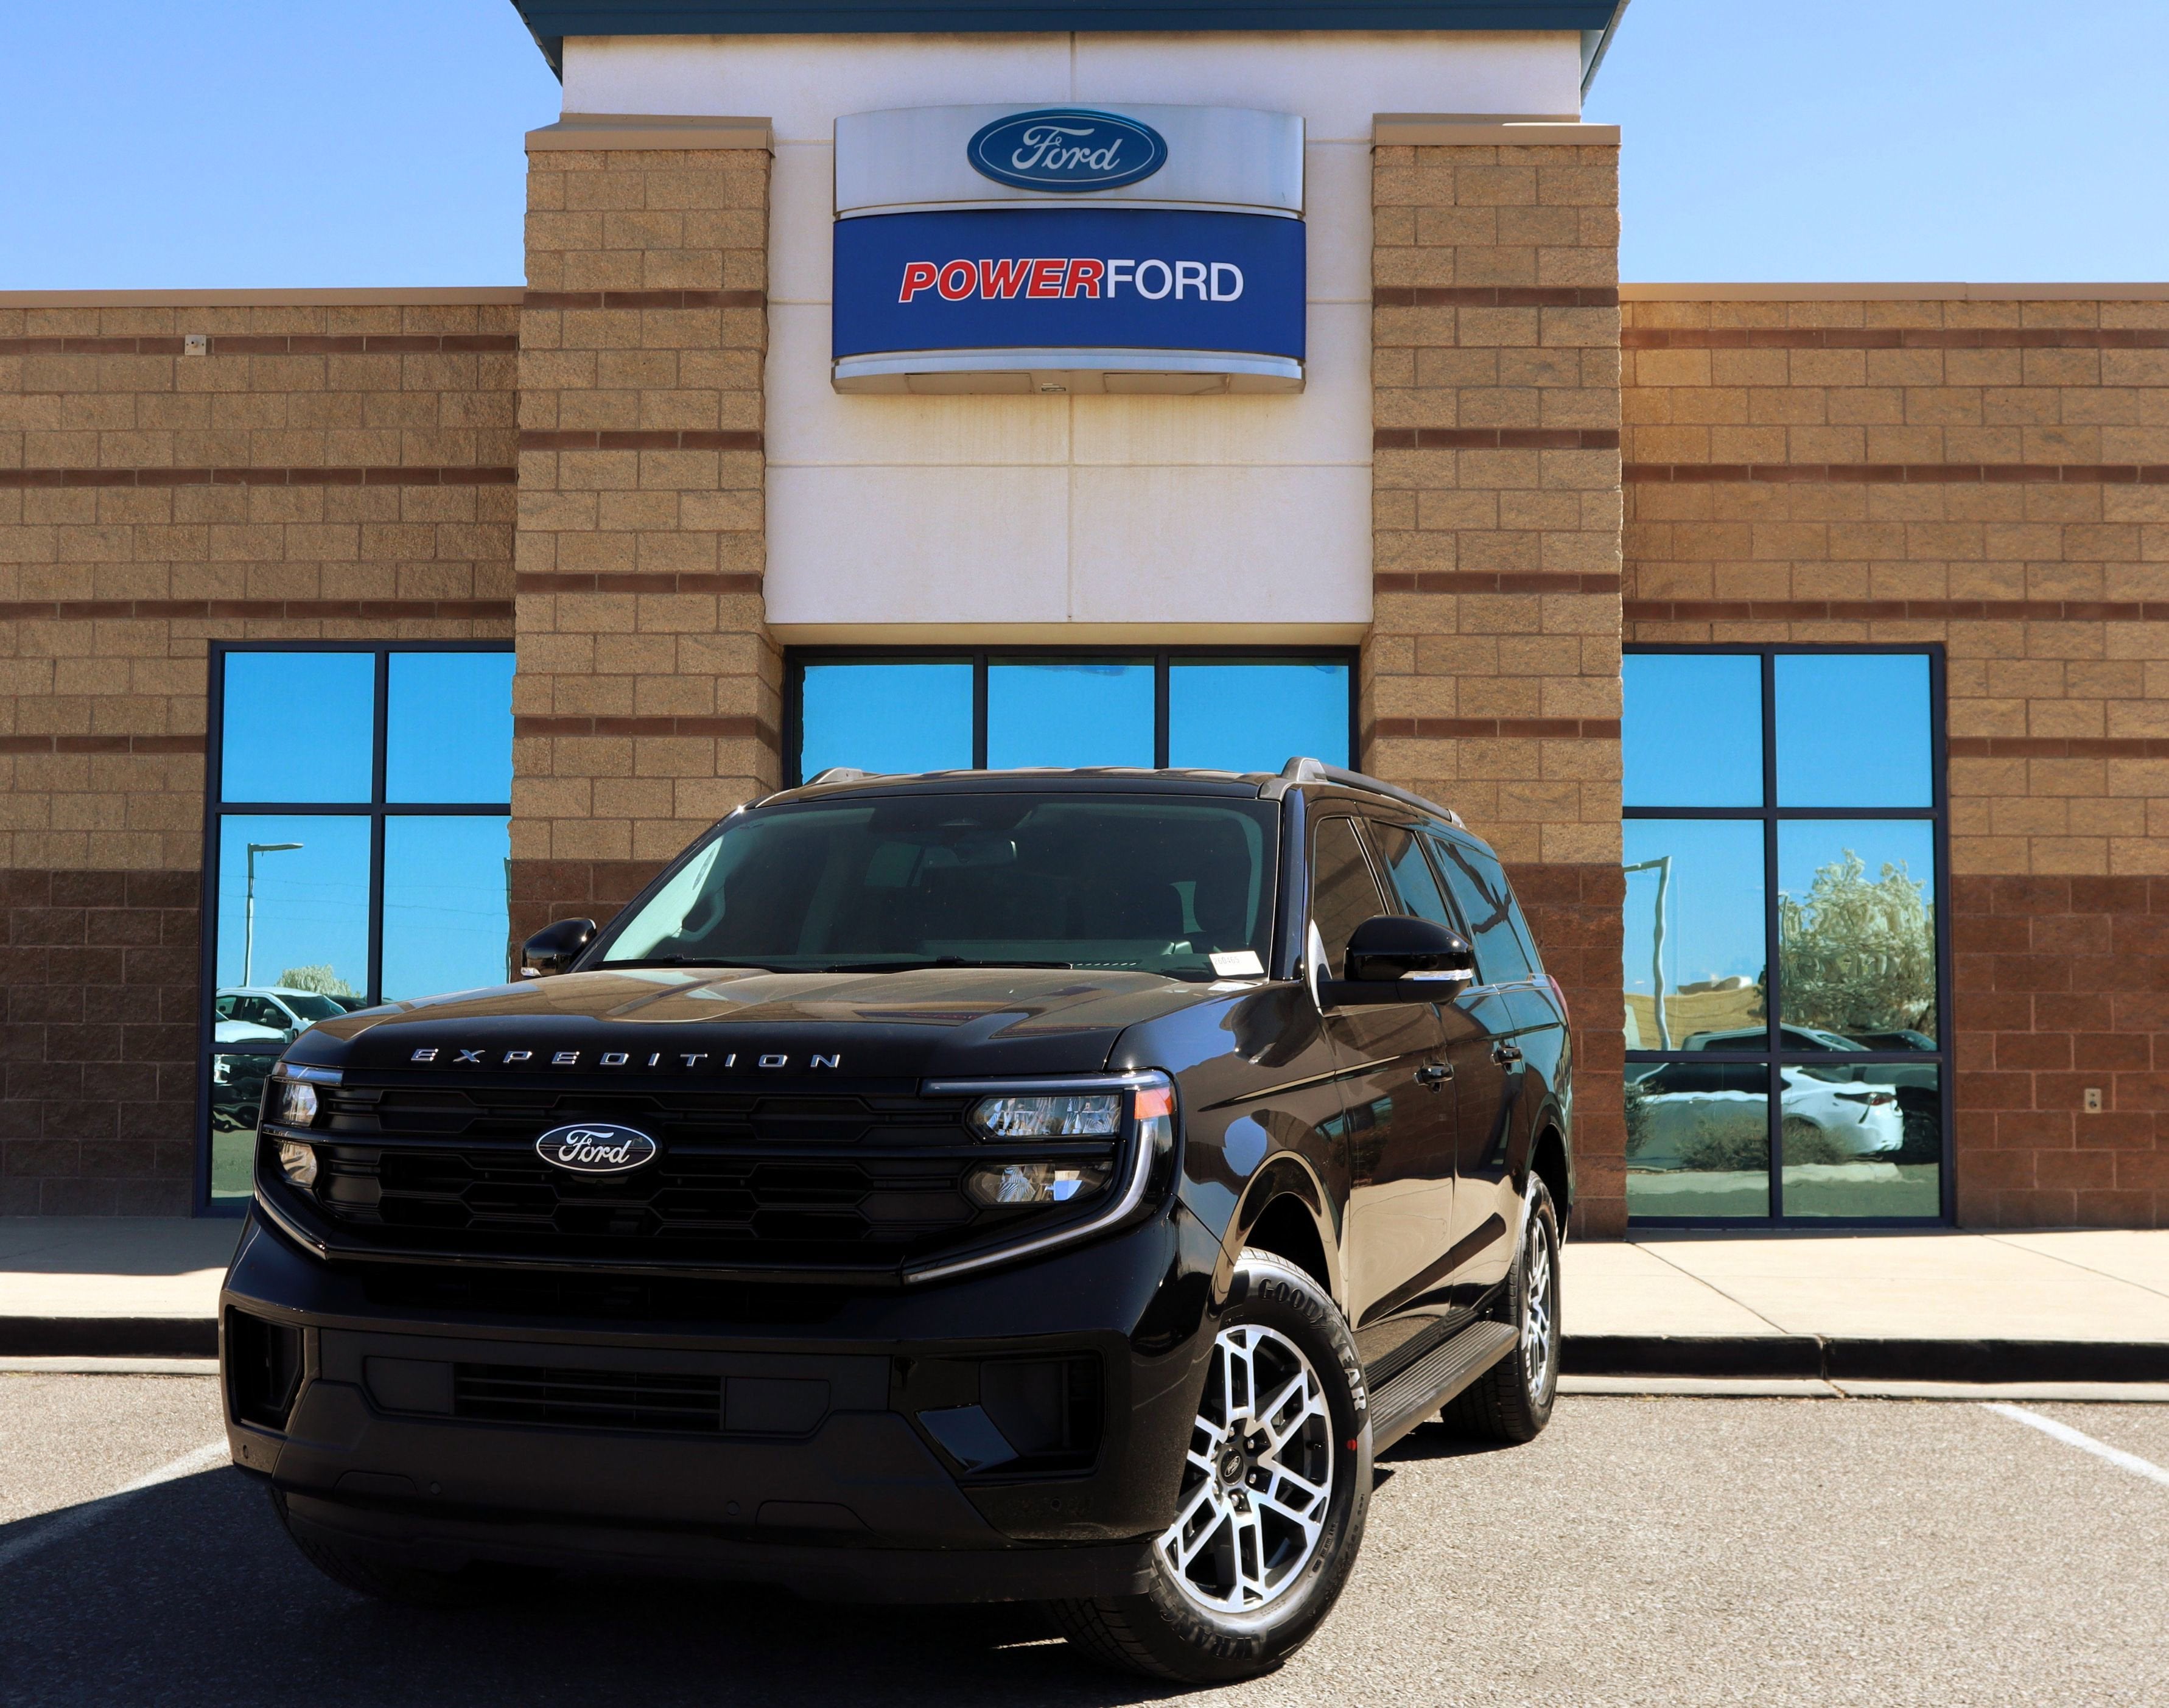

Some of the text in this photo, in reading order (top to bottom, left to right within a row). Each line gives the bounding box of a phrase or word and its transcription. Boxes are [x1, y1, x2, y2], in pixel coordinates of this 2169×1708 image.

[1011, 125, 1124, 171] Ford
[898, 258, 1244, 304] POWERFORD
[410, 1048, 841, 1068] EXPEDITION
[558, 1129, 632, 1164] Ford
